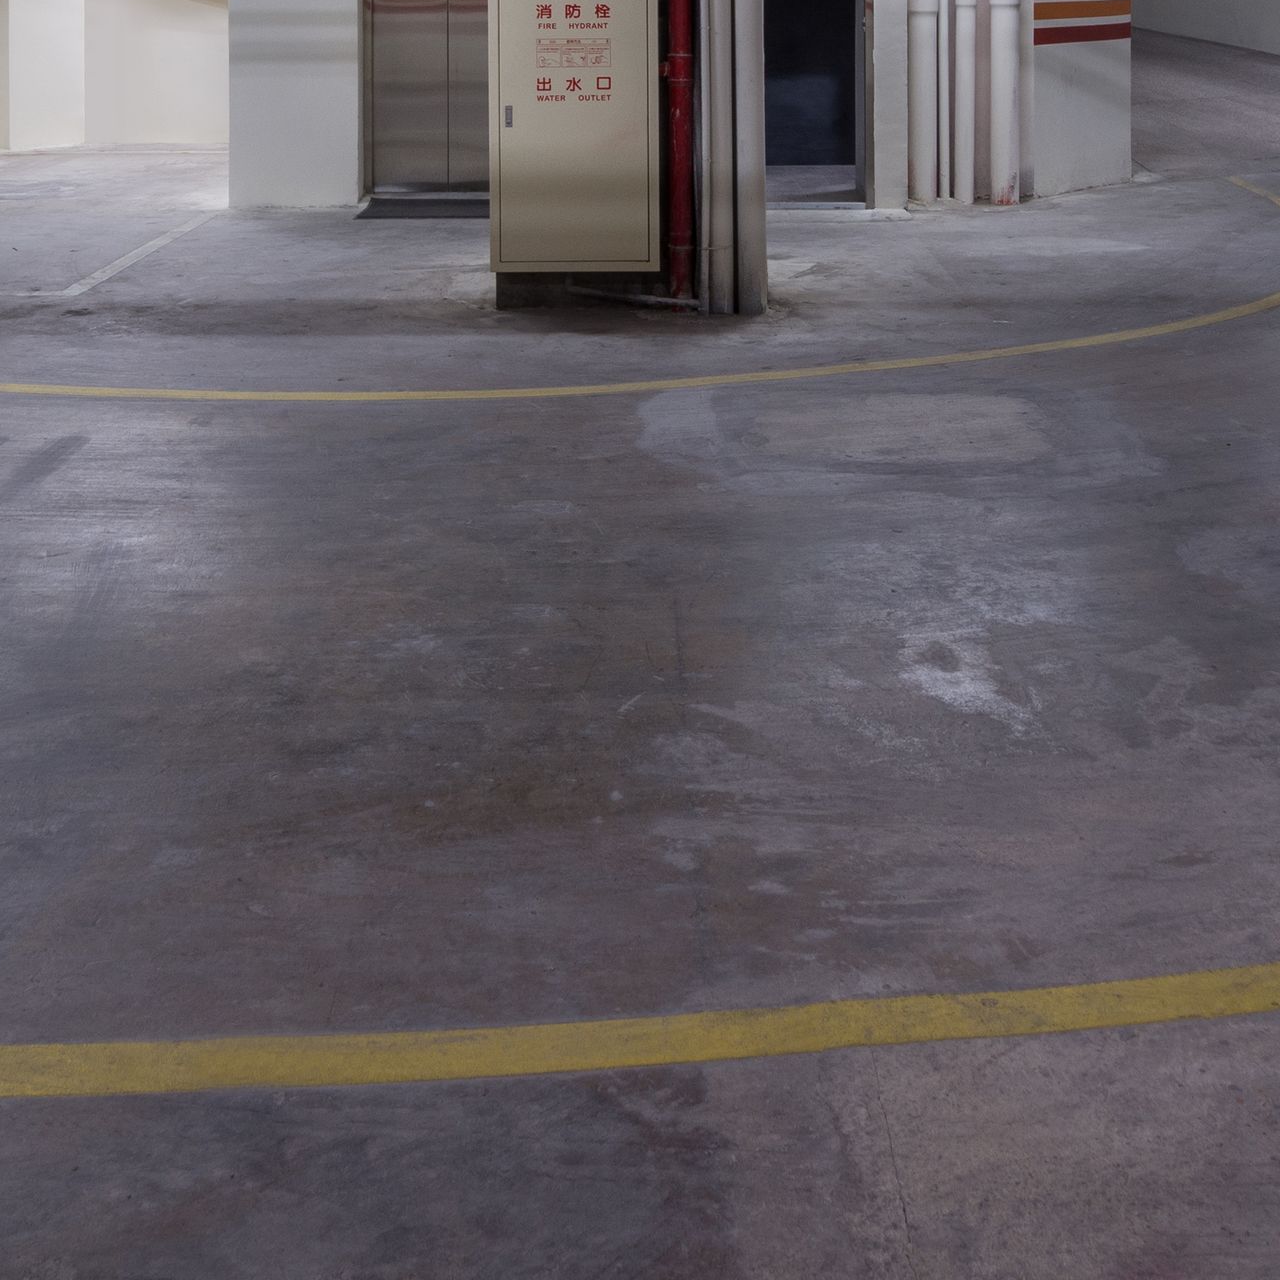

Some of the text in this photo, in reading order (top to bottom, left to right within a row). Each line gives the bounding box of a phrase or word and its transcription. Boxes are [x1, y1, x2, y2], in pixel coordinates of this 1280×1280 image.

[536, 3, 610, 19] 消防栓
[538, 22, 609, 30] FIRE HYDRANT
[536, 76, 611, 92] 出水口
[536, 94, 612, 102] WATER OUTLET
